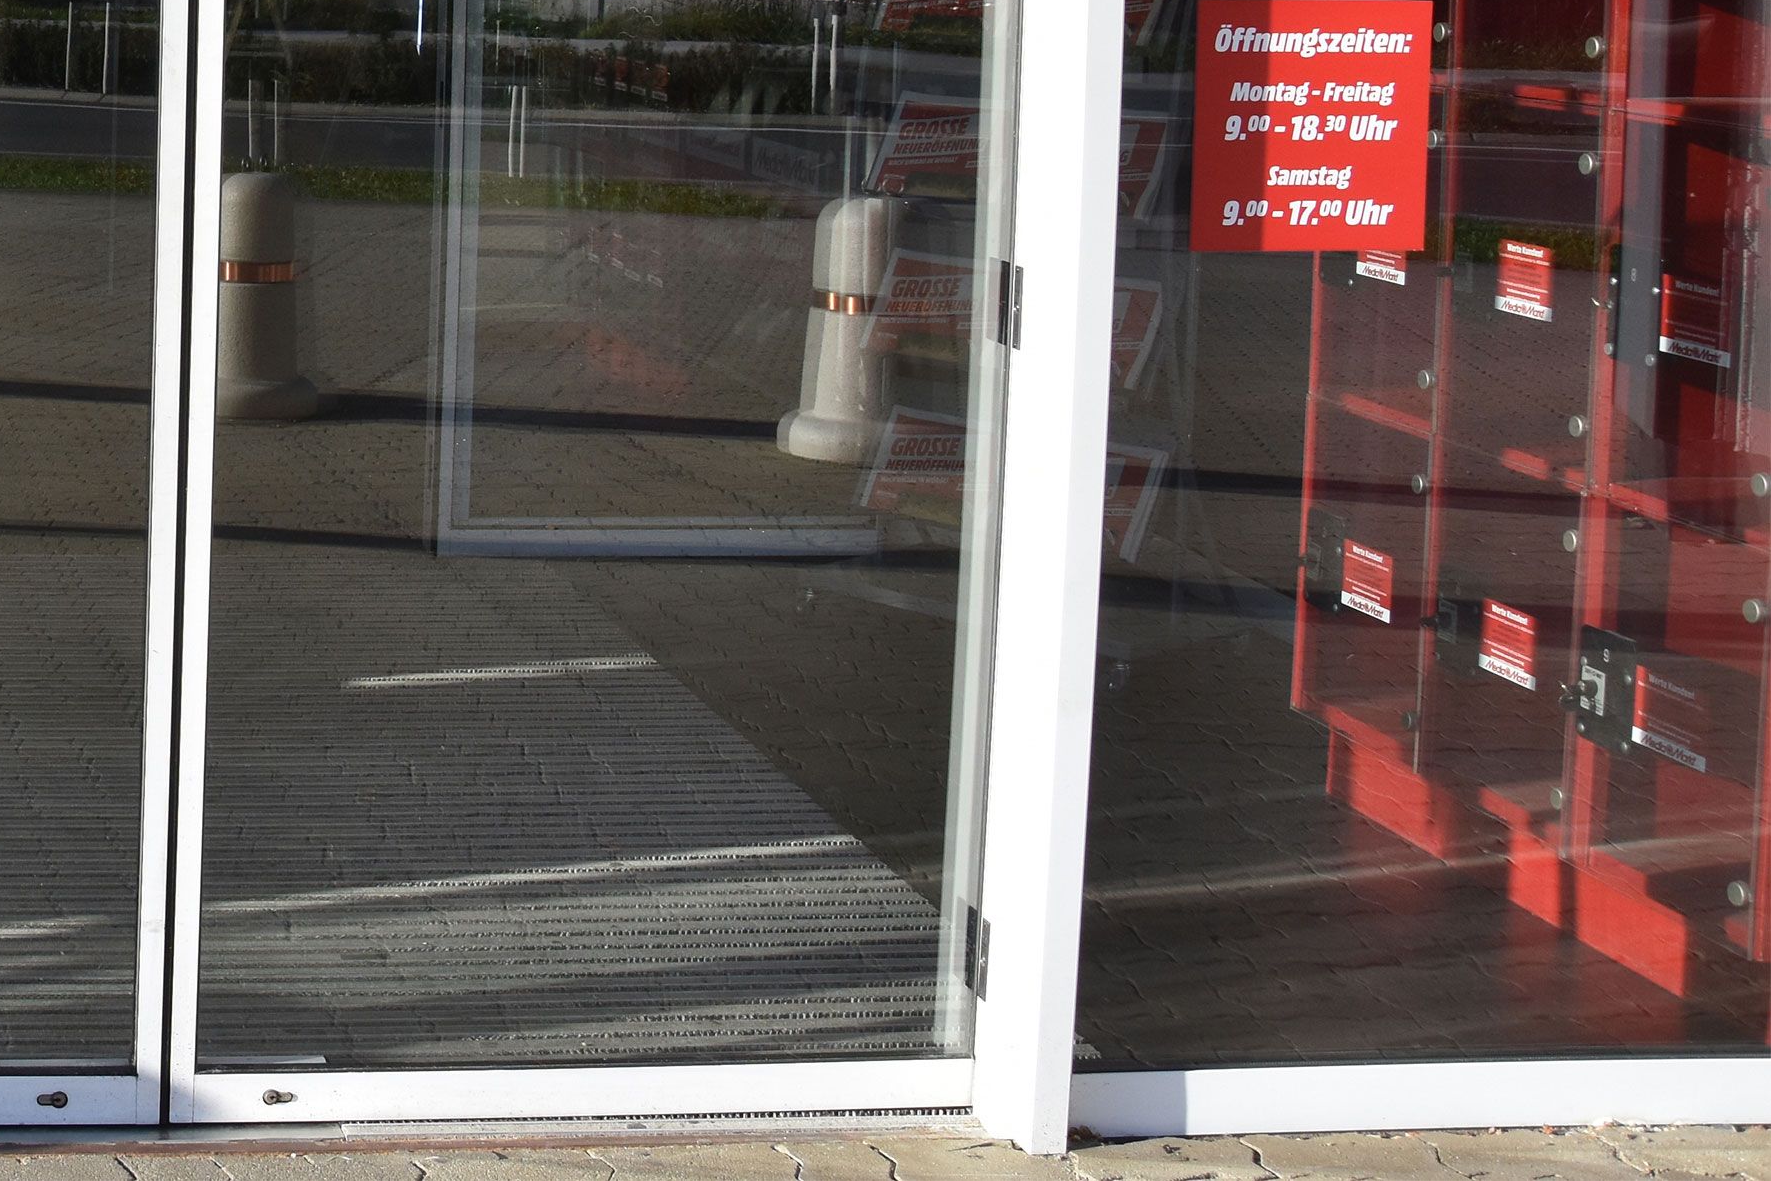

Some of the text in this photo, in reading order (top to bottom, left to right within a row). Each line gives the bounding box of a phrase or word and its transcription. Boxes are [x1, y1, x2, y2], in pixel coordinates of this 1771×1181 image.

[1214, 24, 1413, 58] Öffnungszeiten:
[1229, 82, 1310, 106] Montag
[1323, 82, 1395, 106] Freitag
[898, 118, 970, 140] GROSSE
[1224, 115, 1271, 141] 9.00
[1291, 115, 1346, 141] 18.30
[1349, 114, 1398, 141] Uhr
[1267, 165, 1352, 190] Samstag
[1221, 199, 1269, 226] 9.00
[1288, 199, 1342, 226] 17.00
[1344, 199, 1394, 226] Uhr
[1630, 268, 1637, 282] 8
[891, 278, 962, 298] GROSSE
[890, 436, 960, 457] GROSSE
[1603, 648, 1610, 662] 9
